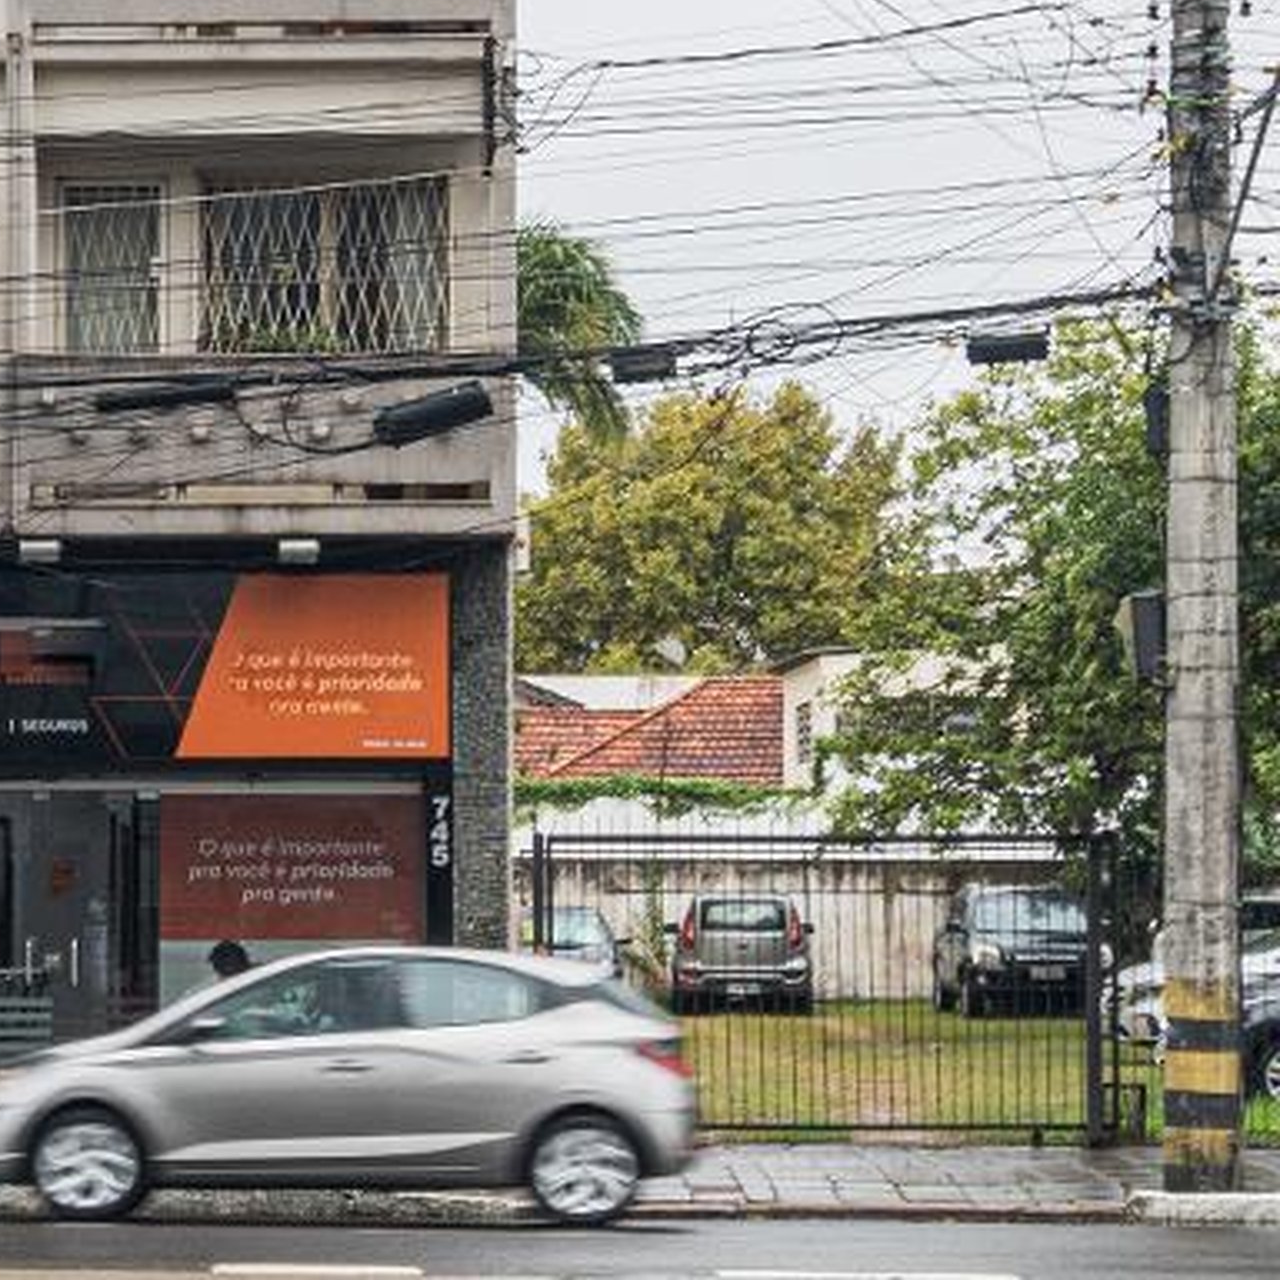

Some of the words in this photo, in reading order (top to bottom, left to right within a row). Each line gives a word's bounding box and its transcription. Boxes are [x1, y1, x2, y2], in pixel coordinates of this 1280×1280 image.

[317, 671, 424, 695] prioridade
[21, 718, 89, 733] SEGUROS
[430, 794, 451, 867] 745
[198, 838, 217, 857] O
